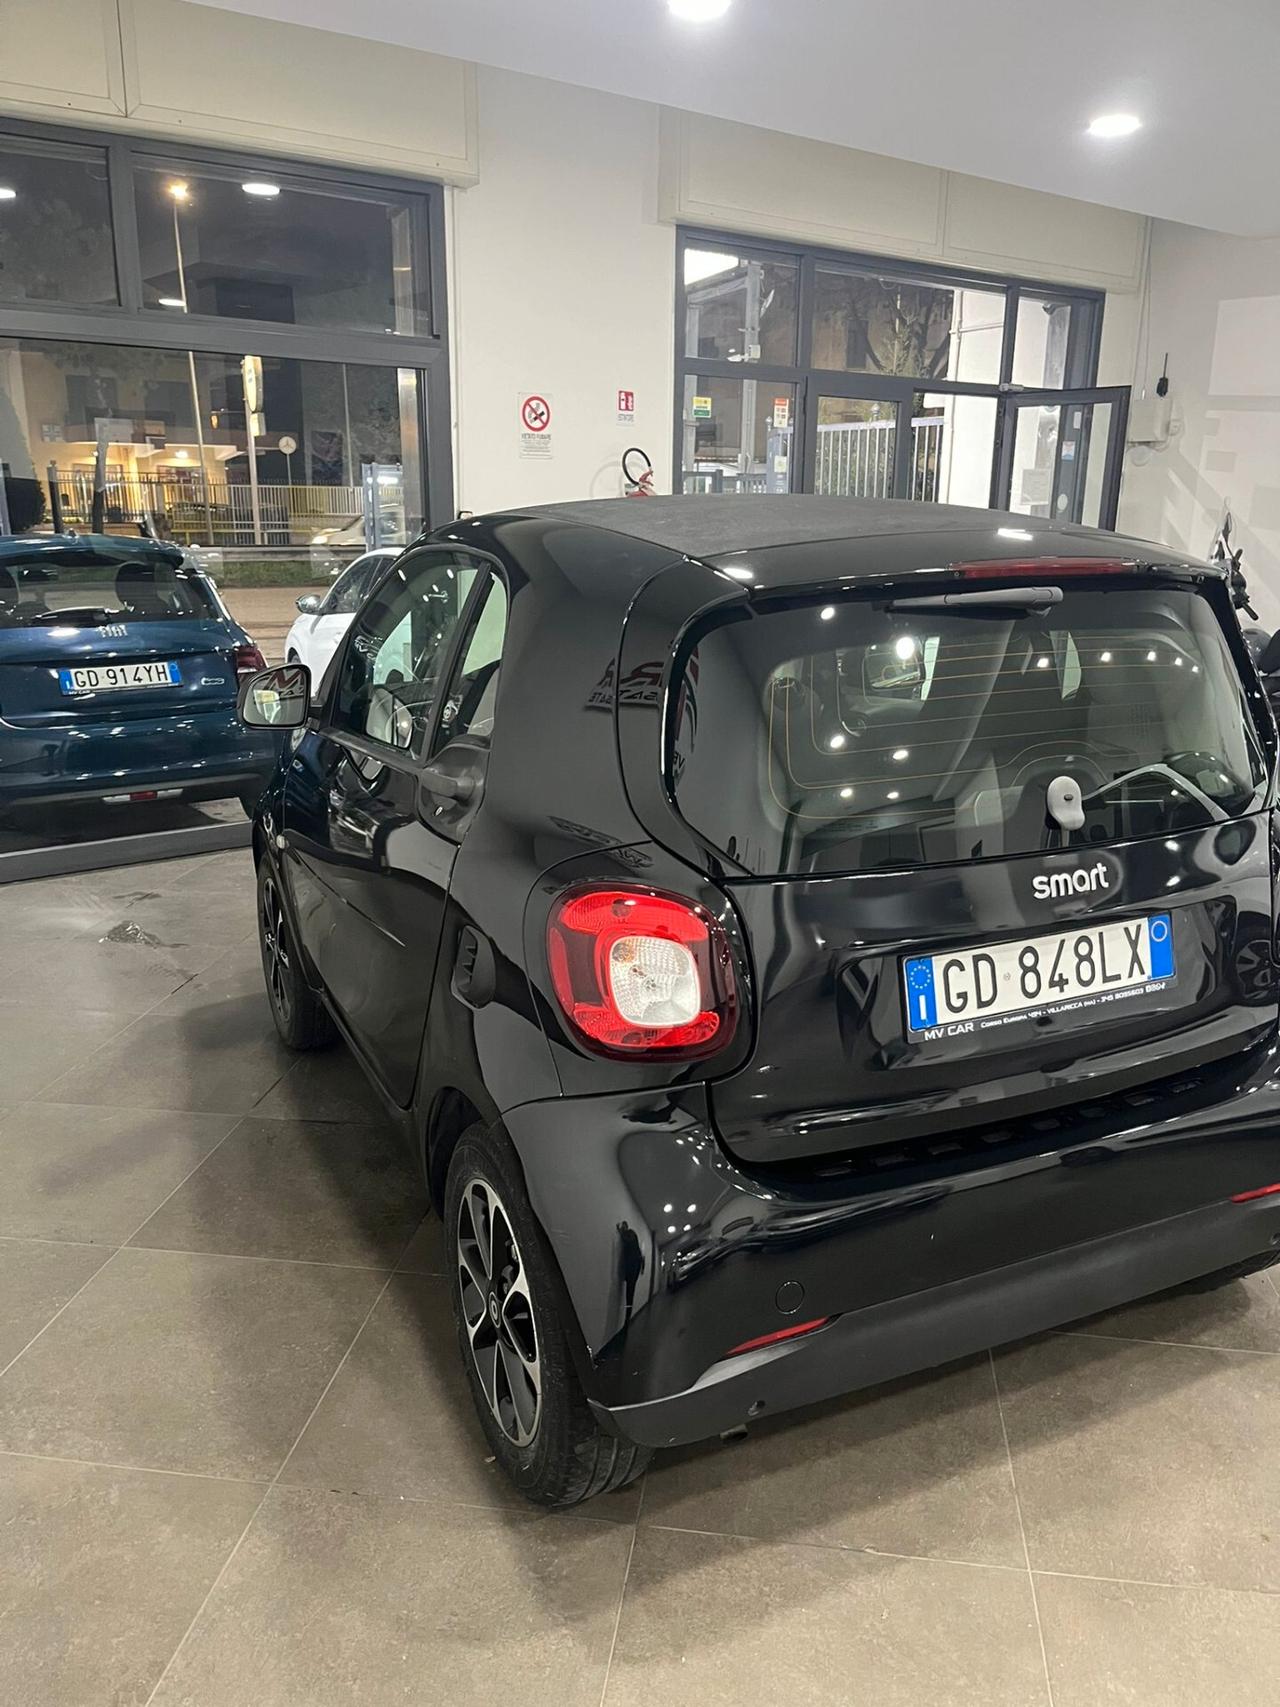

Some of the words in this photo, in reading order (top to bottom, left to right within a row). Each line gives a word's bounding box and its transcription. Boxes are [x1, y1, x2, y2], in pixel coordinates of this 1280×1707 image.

[74, 670, 99, 688] GD
[105, 664, 168, 685] 914YH
[1032, 863, 1109, 900] smart
[942, 952, 998, 1014] GD
[1018, 923, 1146, 1000] 848LX
[924, 1028, 945, 1041] MV
[947, 1022, 975, 1036] CAR
[1047, 1000, 1083, 1014] VILLARICCA
